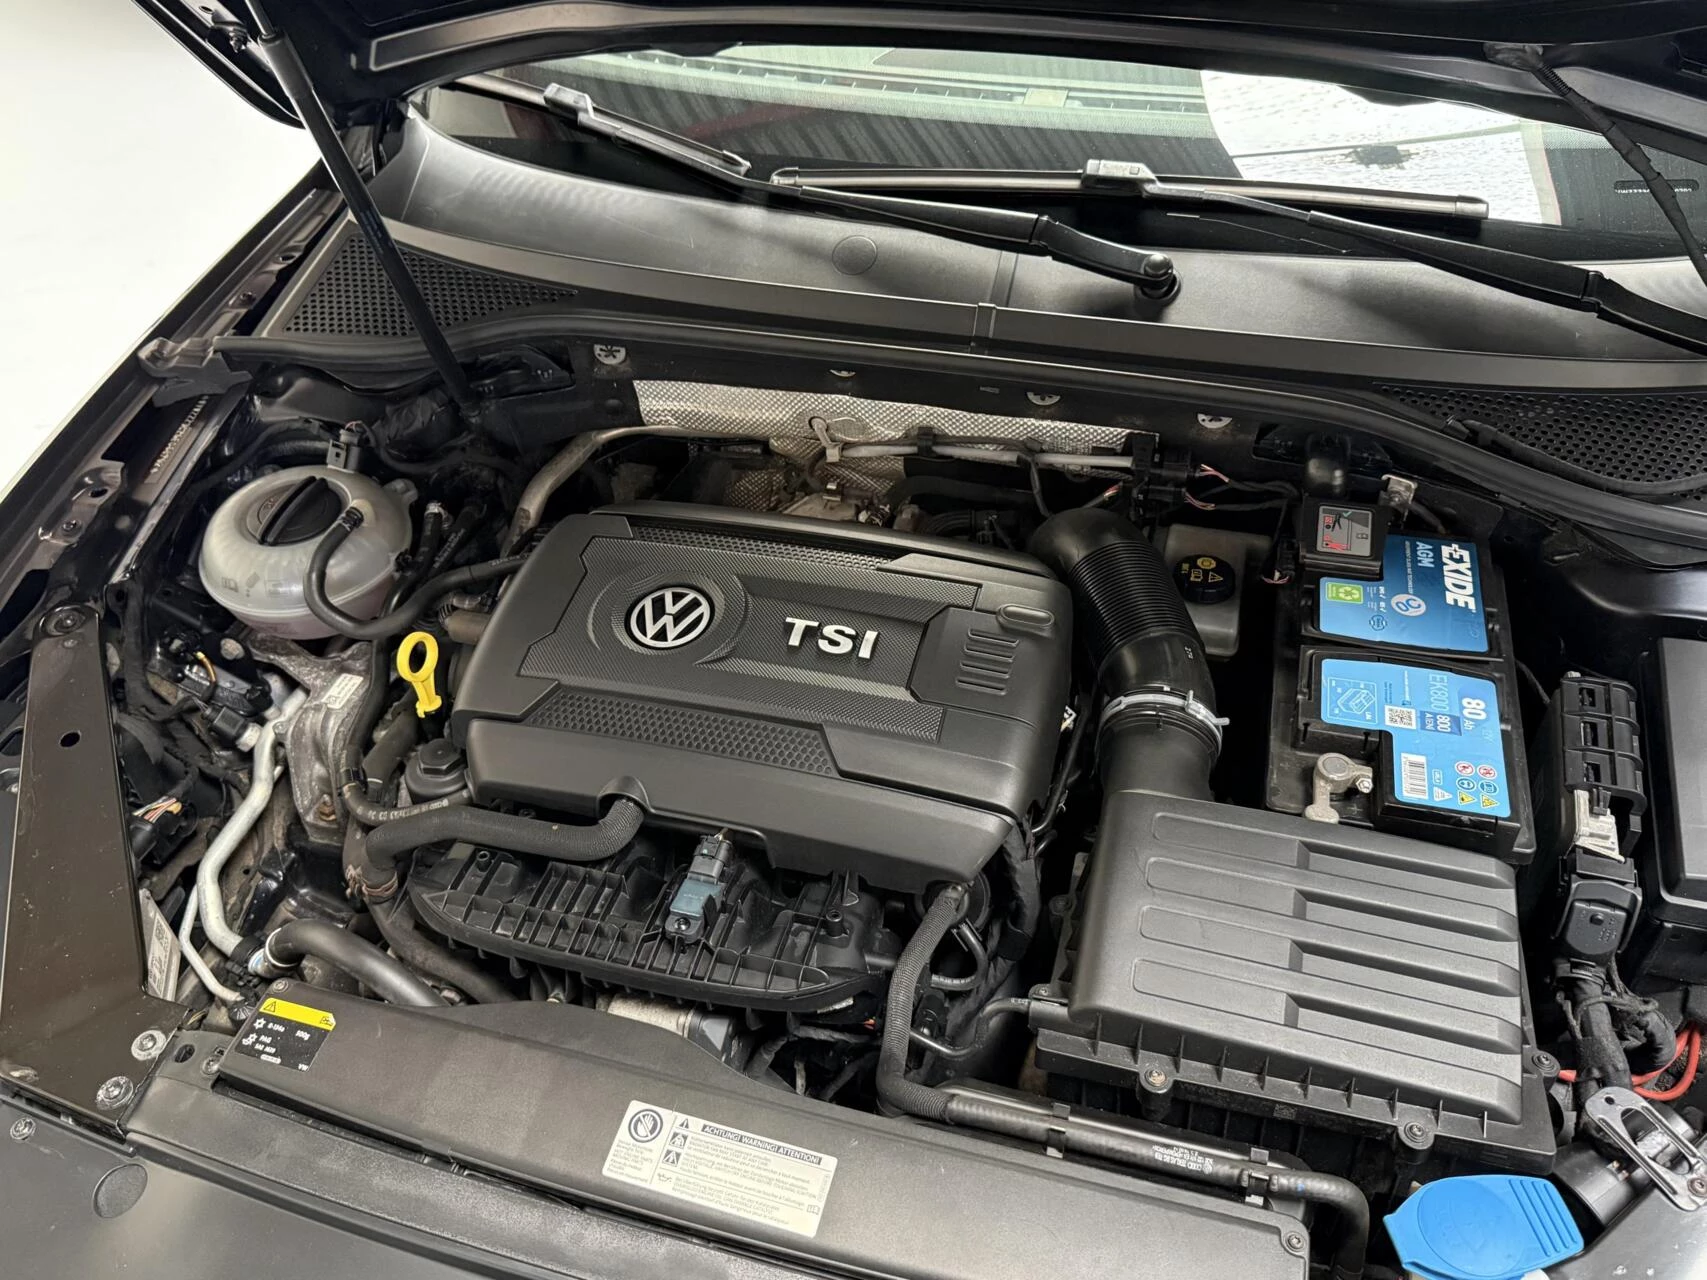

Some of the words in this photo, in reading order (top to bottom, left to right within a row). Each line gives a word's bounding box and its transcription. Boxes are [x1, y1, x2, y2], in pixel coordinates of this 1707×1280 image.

[1416, 542, 1435, 568] AGM
[1441, 544, 1476, 613] EXIDE
[785, 617, 880, 660] TSI
[1429, 673, 1449, 711] EK800
[1436, 714, 1451, 732] 800
[1462, 697, 1487, 720] 80
[1463, 720, 1474, 730] Ah
[704, 1125, 742, 1142] ACHTUNG!
[742, 1135, 778, 1153] WARNING!
[778, 1145, 821, 1164] ATTENTION!
